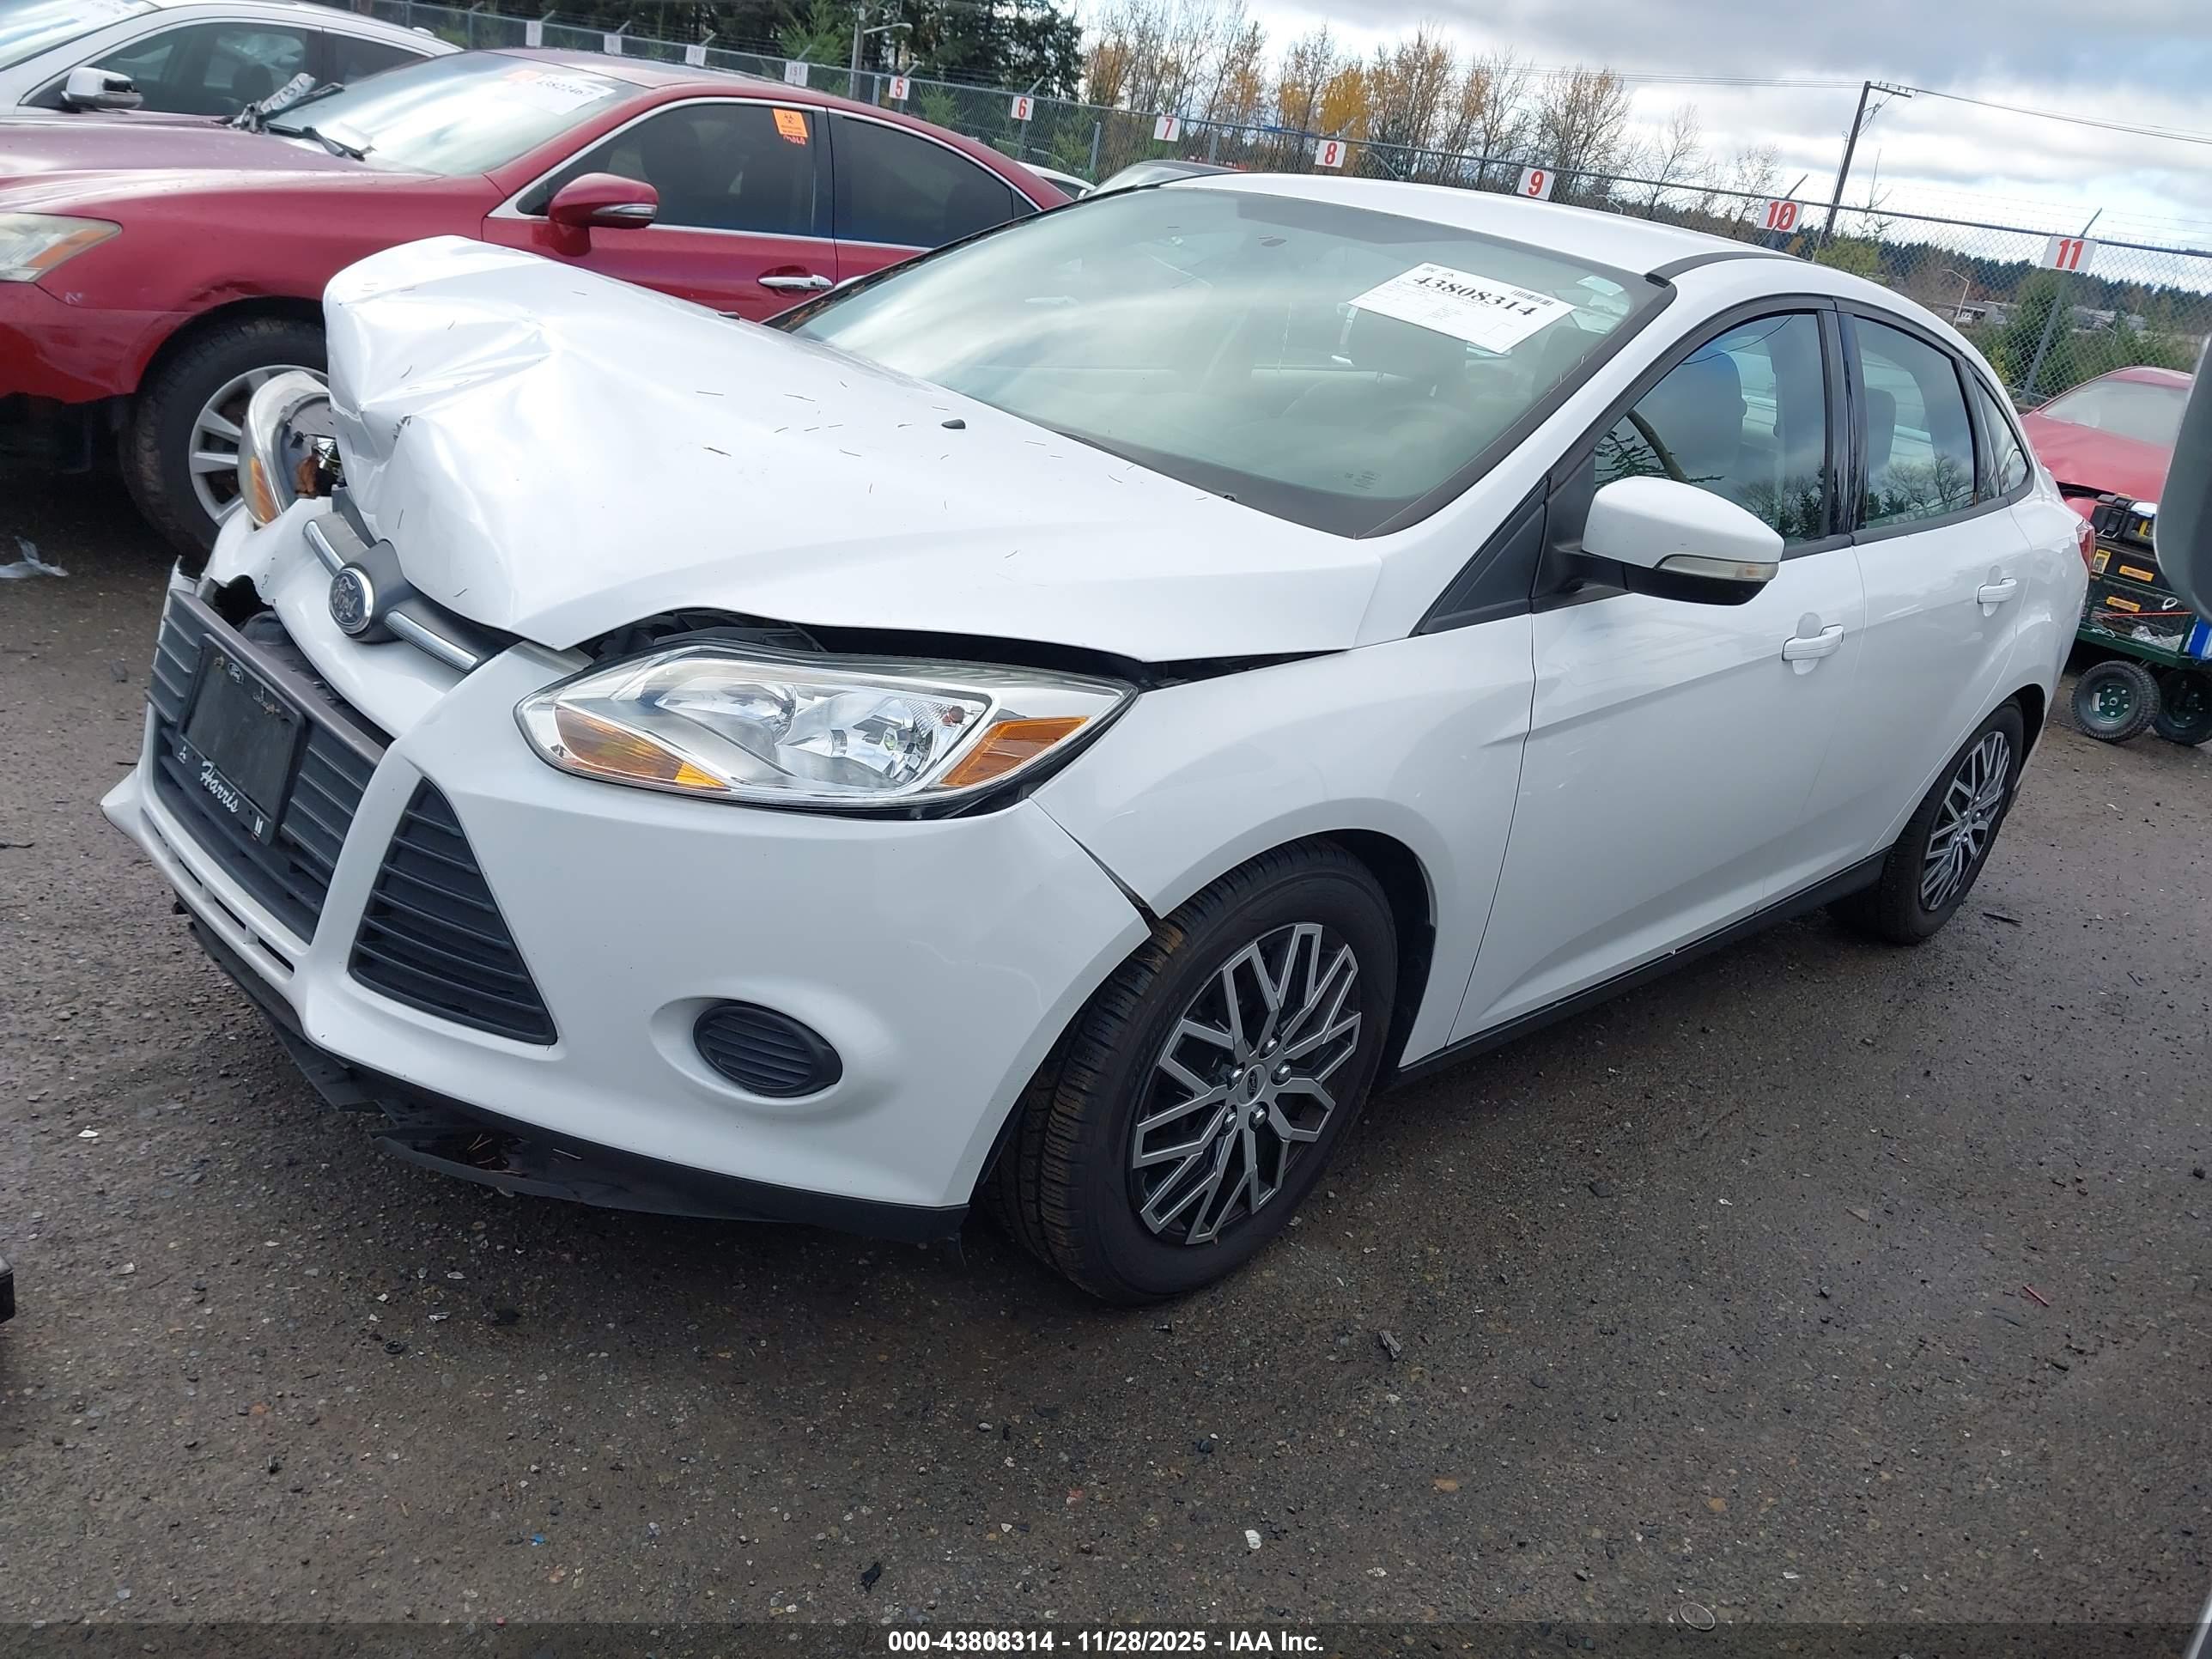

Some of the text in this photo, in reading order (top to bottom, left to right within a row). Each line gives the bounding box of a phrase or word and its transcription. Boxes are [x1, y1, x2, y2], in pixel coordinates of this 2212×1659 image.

[895, 78, 904, 97] 5
[1018, 98, 1028, 118] 6
[1165, 118, 1173, 139] 7
[1324, 142, 1338, 165] 8
[1528, 171, 1544, 196] 9
[1766, 201, 1797, 230] 10
[2056, 239, 2084, 270] 11
[1412, 276, 1539, 317] 43808314
[333, 574, 359, 619] Ford
[199, 761, 239, 813] Harris
